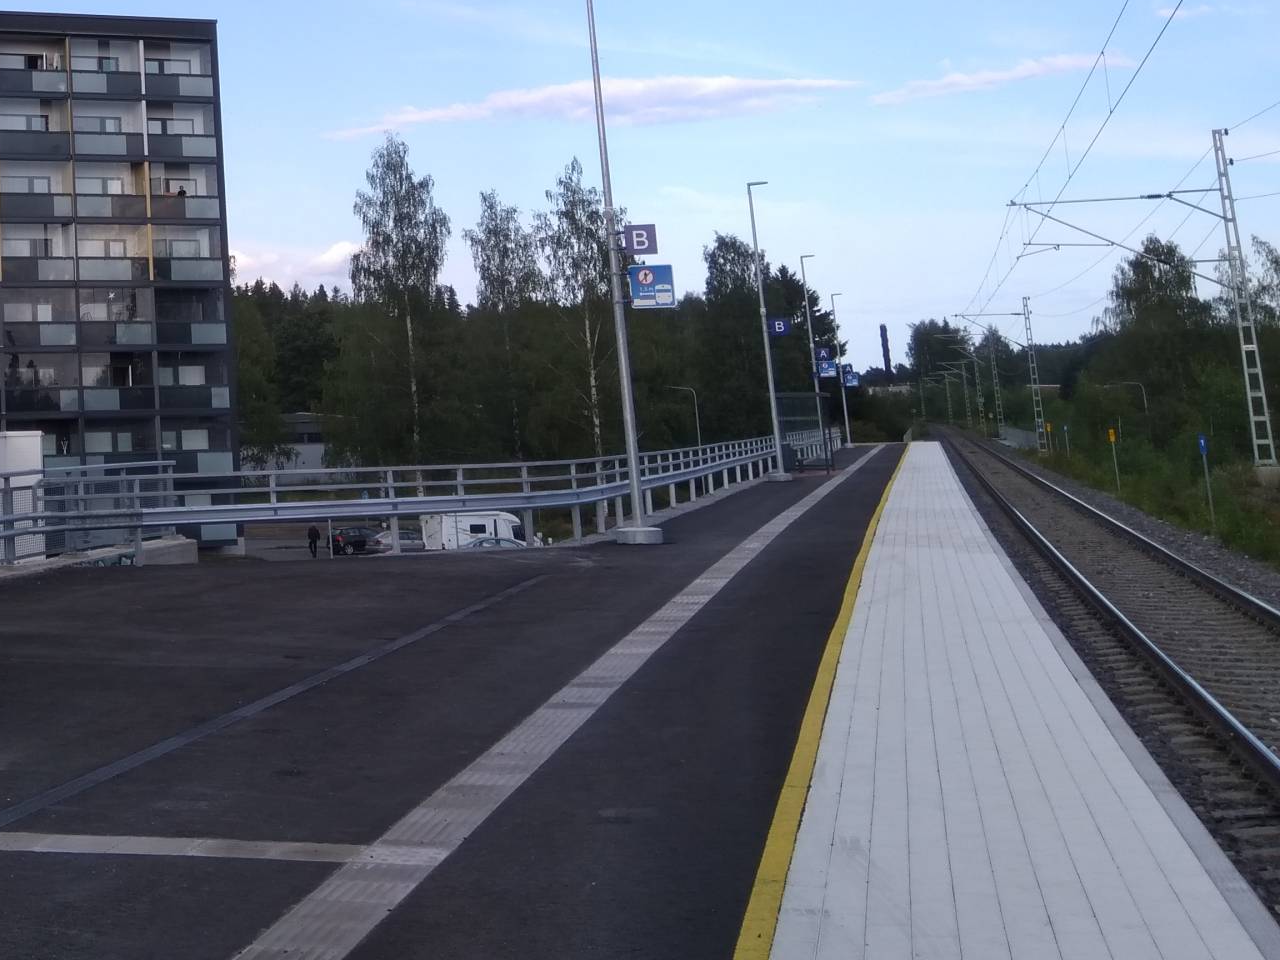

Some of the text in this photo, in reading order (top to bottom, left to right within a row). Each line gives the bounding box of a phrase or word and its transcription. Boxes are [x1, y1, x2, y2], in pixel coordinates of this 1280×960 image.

[632, 230, 649, 250] B
[775, 321, 785, 332] B
[820, 350, 827, 358] A
